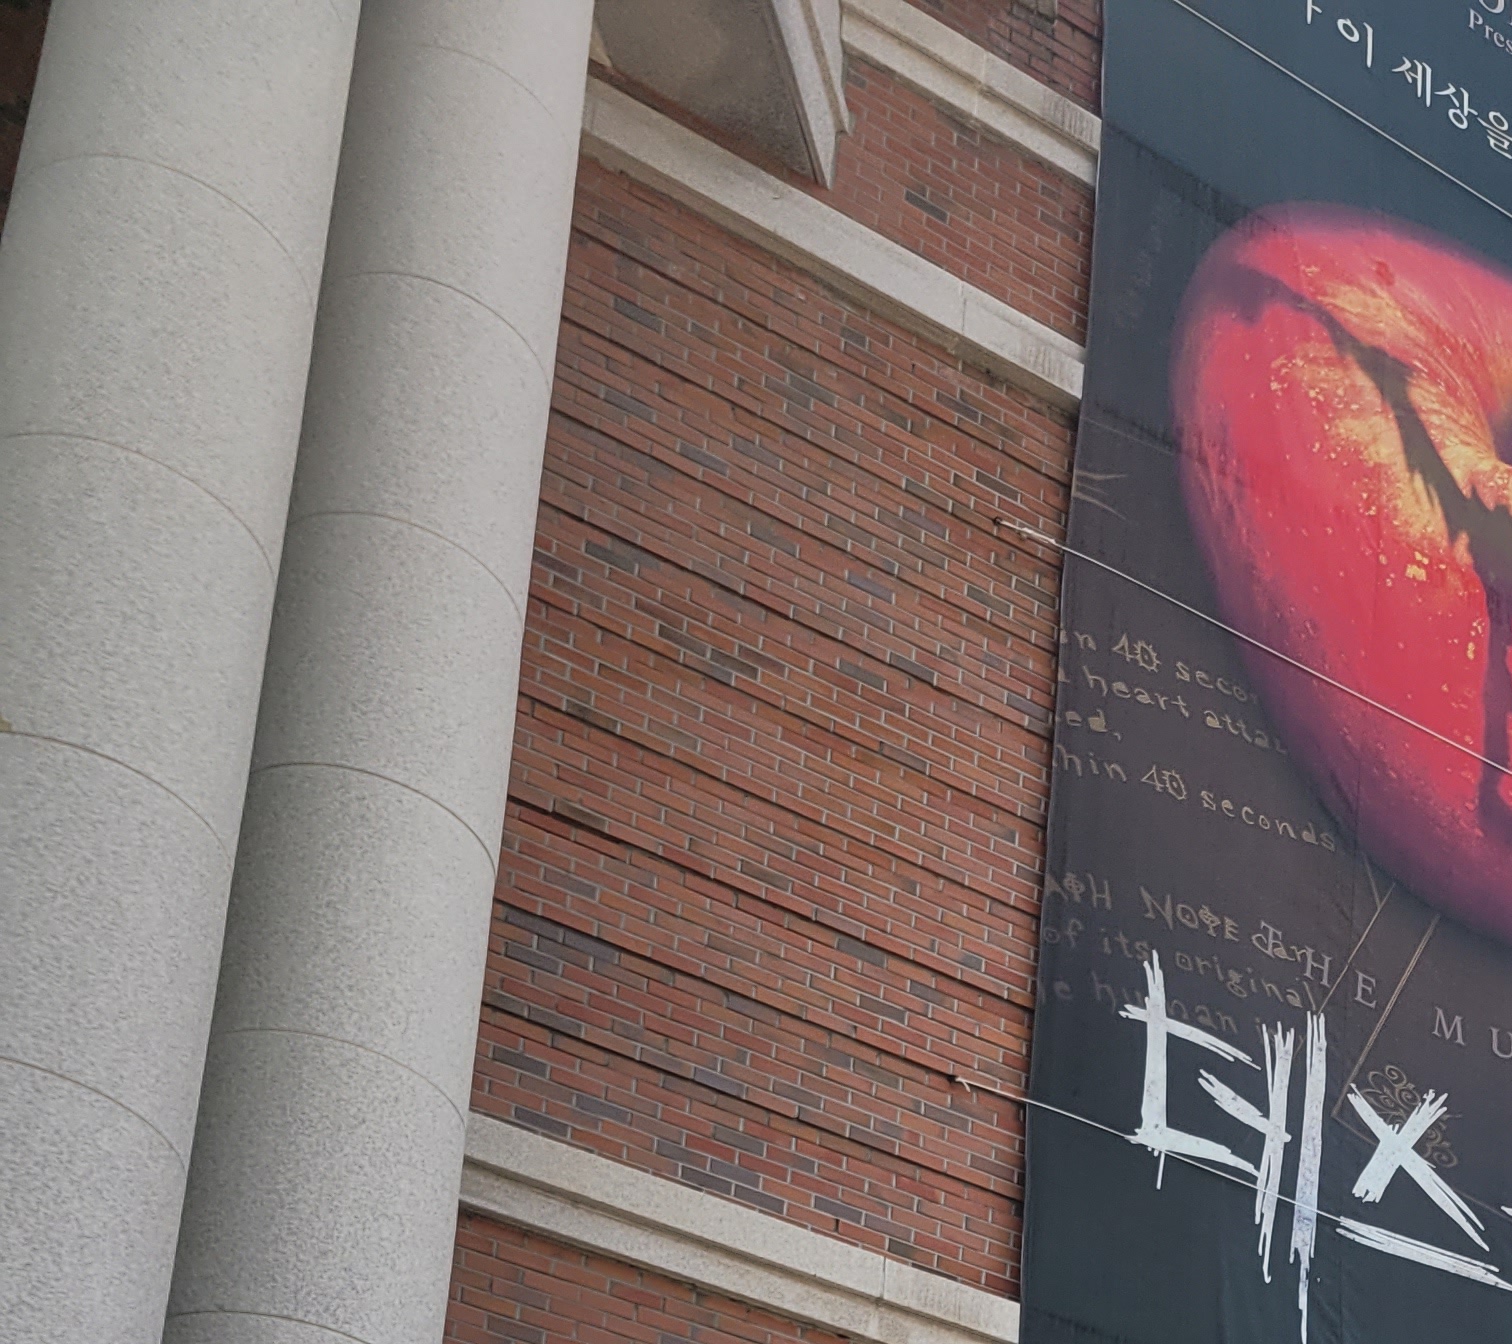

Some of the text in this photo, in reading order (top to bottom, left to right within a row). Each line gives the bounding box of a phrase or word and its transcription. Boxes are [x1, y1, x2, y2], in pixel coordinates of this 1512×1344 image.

[1336, 18, 1374, 68] 이
[1082, 665, 1190, 718] heart
[1200, 790, 1337, 852] seconds
[1173, 949, 1317, 1013] original
[1260, 919, 1378, 1008] THE
